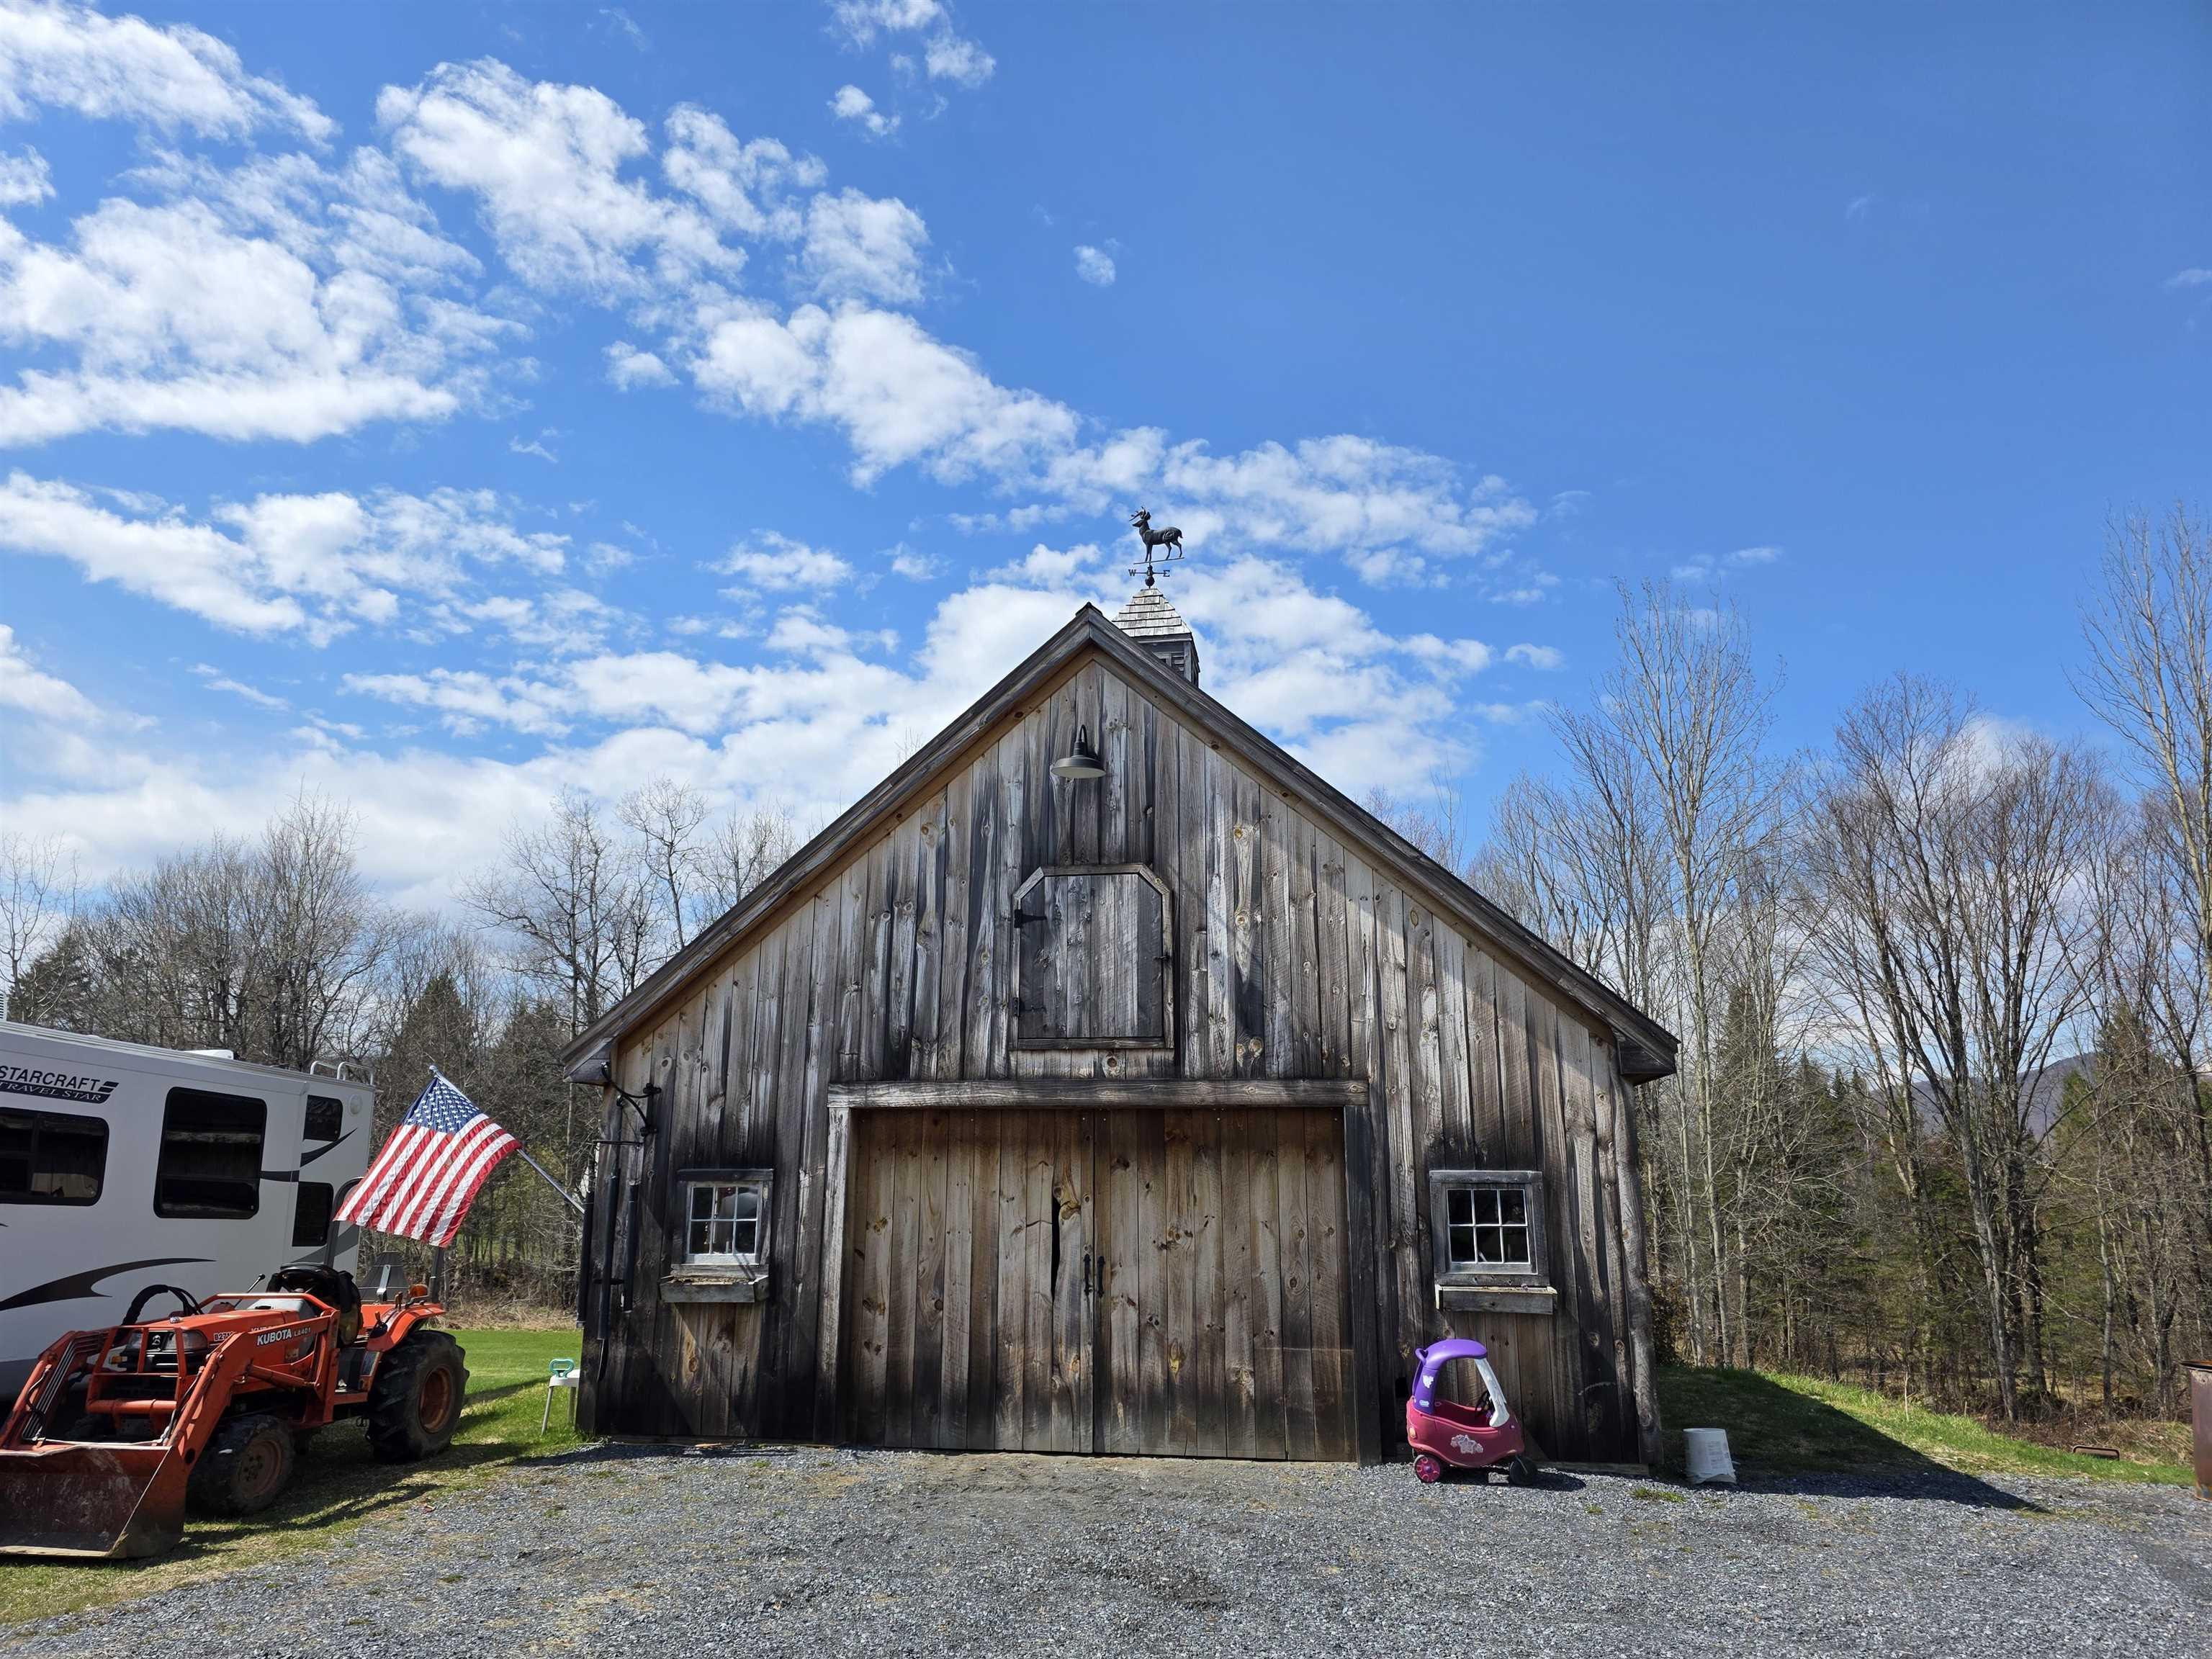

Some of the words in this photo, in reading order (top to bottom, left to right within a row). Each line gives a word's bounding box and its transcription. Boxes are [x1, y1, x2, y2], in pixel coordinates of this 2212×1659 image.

[0, 1065, 100, 1091] STARCRAFT
[62, 1090, 101, 1101] STAR
[256, 1328, 292, 1346] KUBOTA
